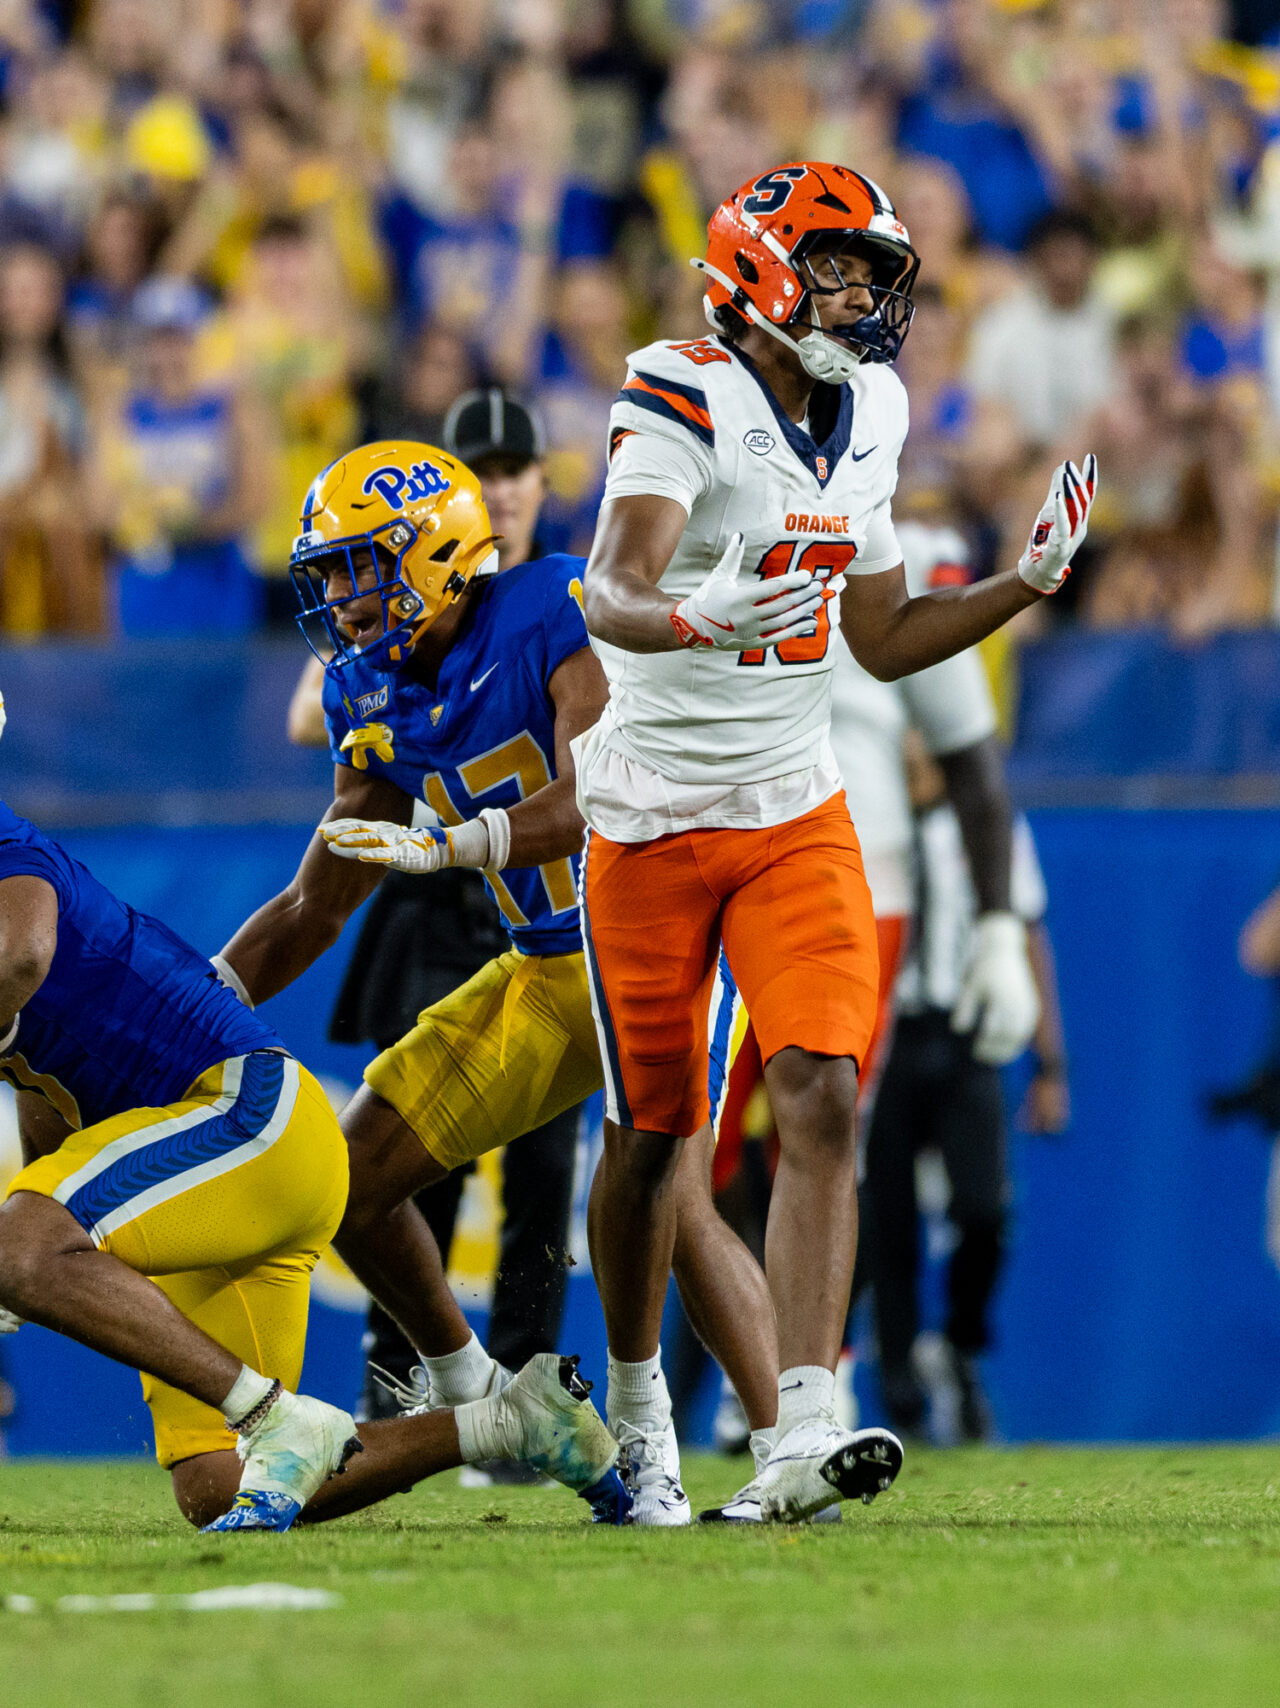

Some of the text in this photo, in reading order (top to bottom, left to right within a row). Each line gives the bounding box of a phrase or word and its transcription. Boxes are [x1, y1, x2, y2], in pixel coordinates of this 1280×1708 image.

[742, 167, 808, 215] S
[749, 435, 770, 446] ACC
[815, 456, 827, 479] S
[363, 461, 451, 511] Pitt
[785, 513, 849, 533] ORANGE
